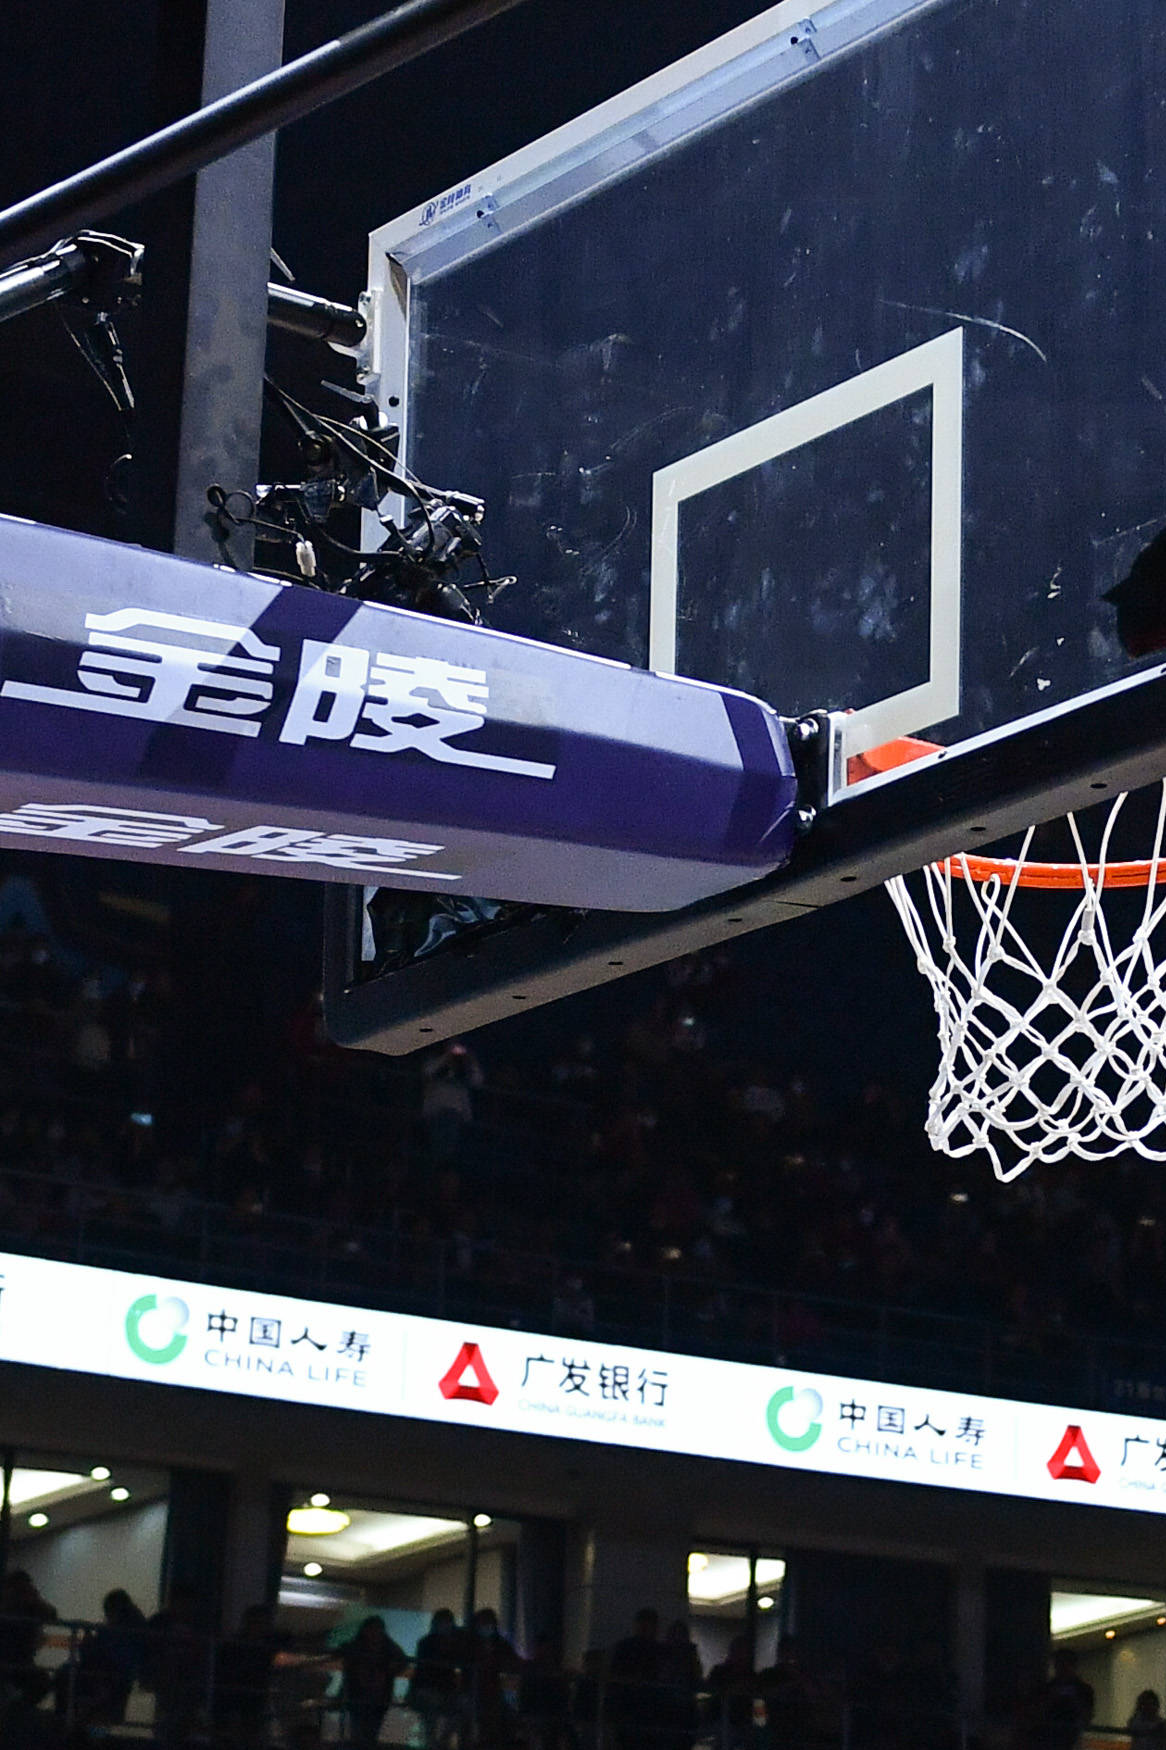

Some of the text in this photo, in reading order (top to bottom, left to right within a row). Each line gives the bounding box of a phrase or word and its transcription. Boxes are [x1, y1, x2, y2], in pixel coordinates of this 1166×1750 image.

[3, 608, 556, 779] 金陵
[206, 1308, 372, 1363] 中国人寿
[203, 1349, 368, 1388] CHINA LIFE
[521, 1353, 668, 1407] 广发银行
[838, 1398, 986, 1447] 中国人寿
[837, 1436, 984, 1470] CHINA LIFE
